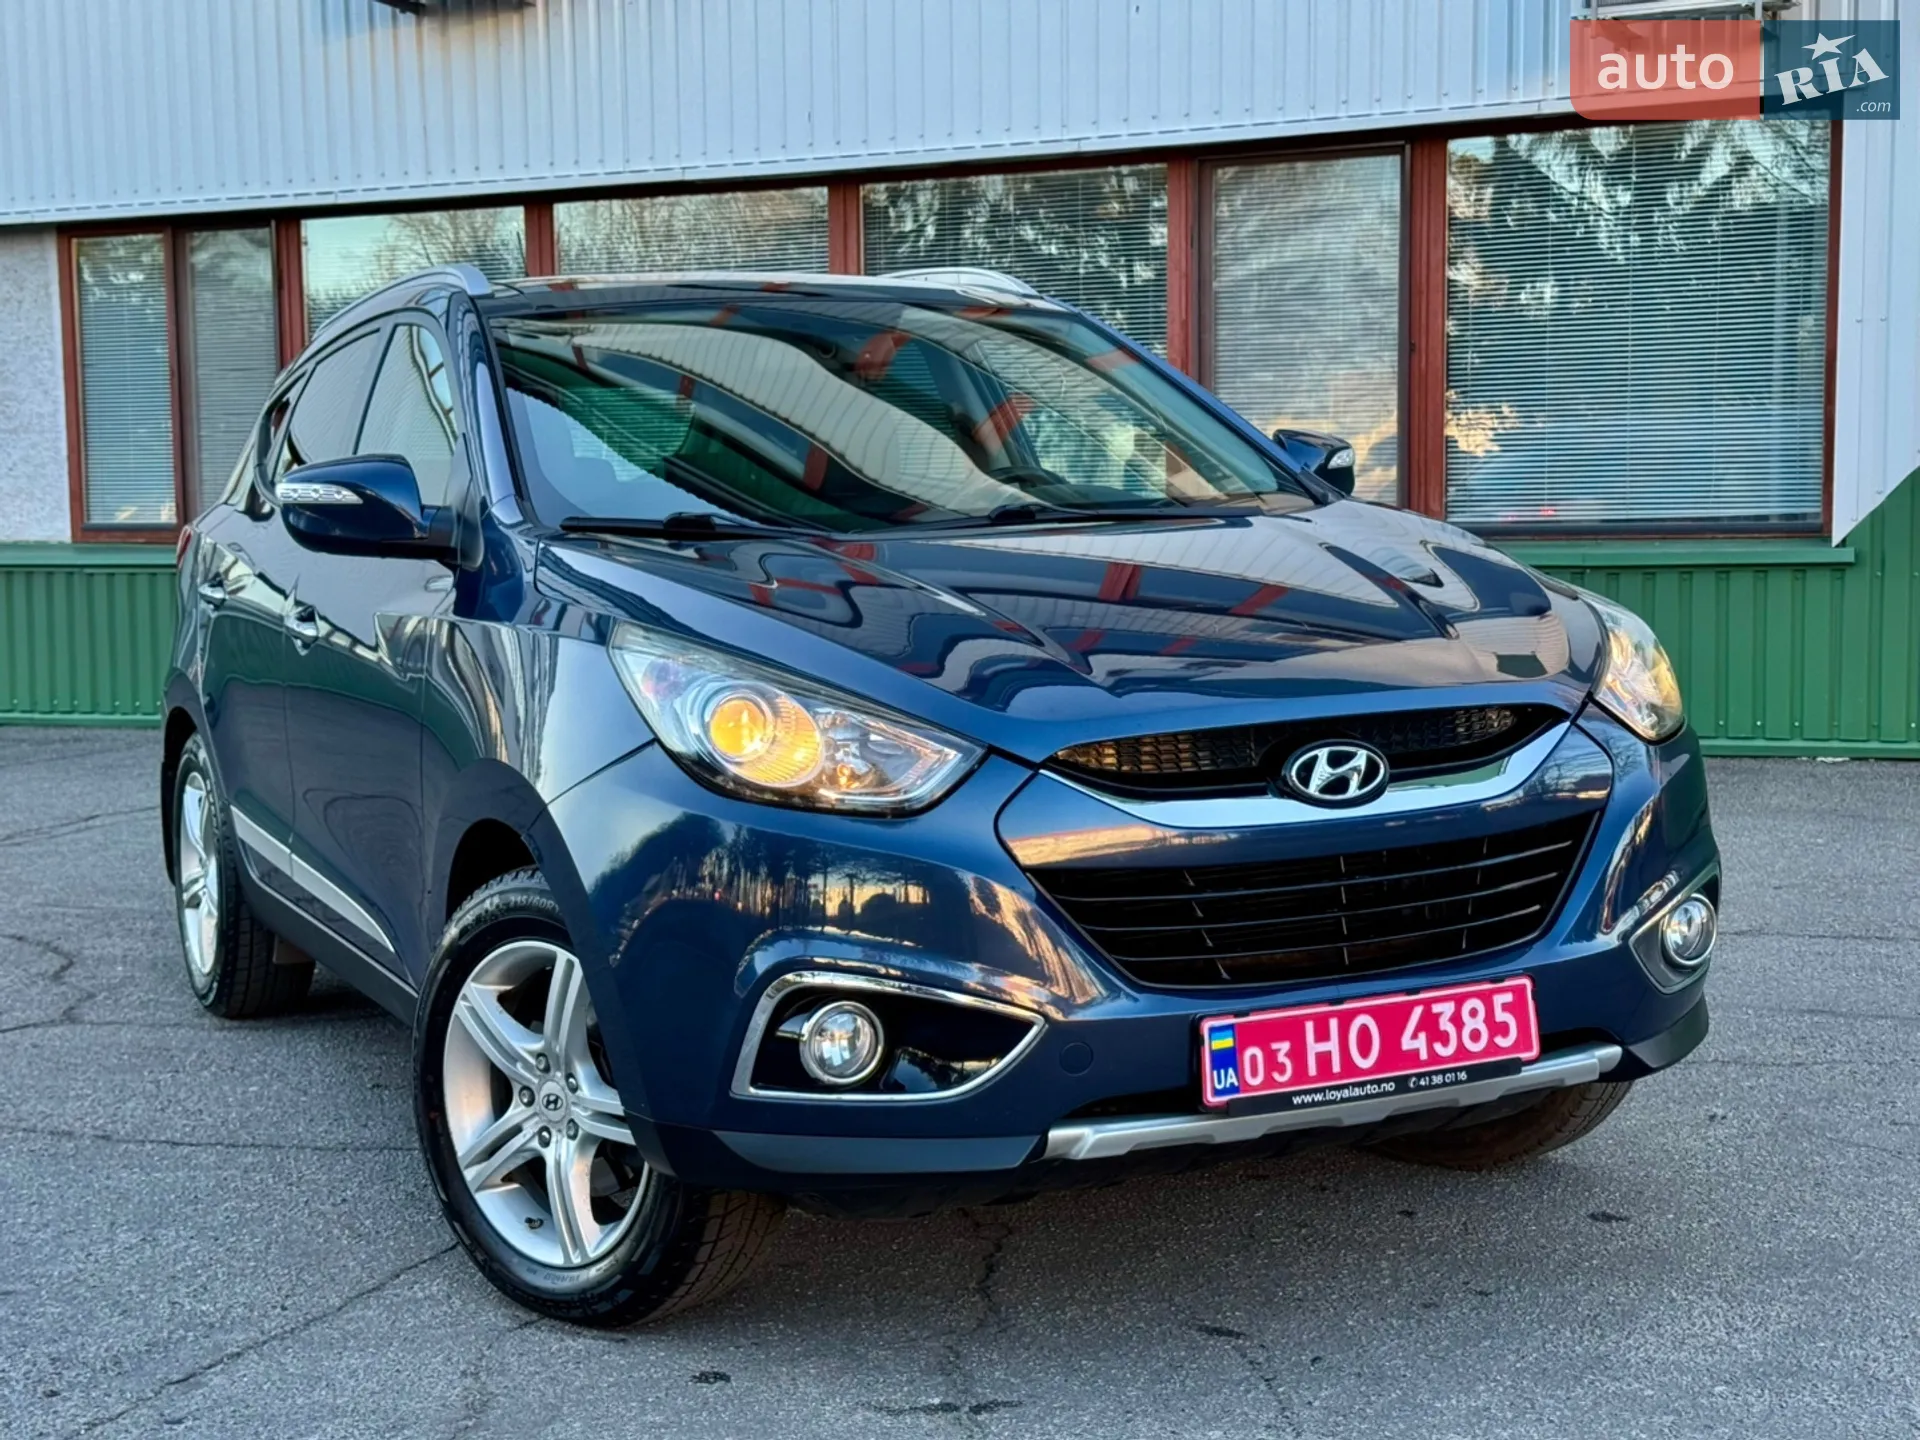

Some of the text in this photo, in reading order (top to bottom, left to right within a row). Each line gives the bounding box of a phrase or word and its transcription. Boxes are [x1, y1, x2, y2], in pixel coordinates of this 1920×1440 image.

[1243, 991, 1518, 1086] 03 HO 4385
[1213, 1066, 1239, 1089] UA
[1292, 1081, 1395, 1105] www.loyalauto.no
